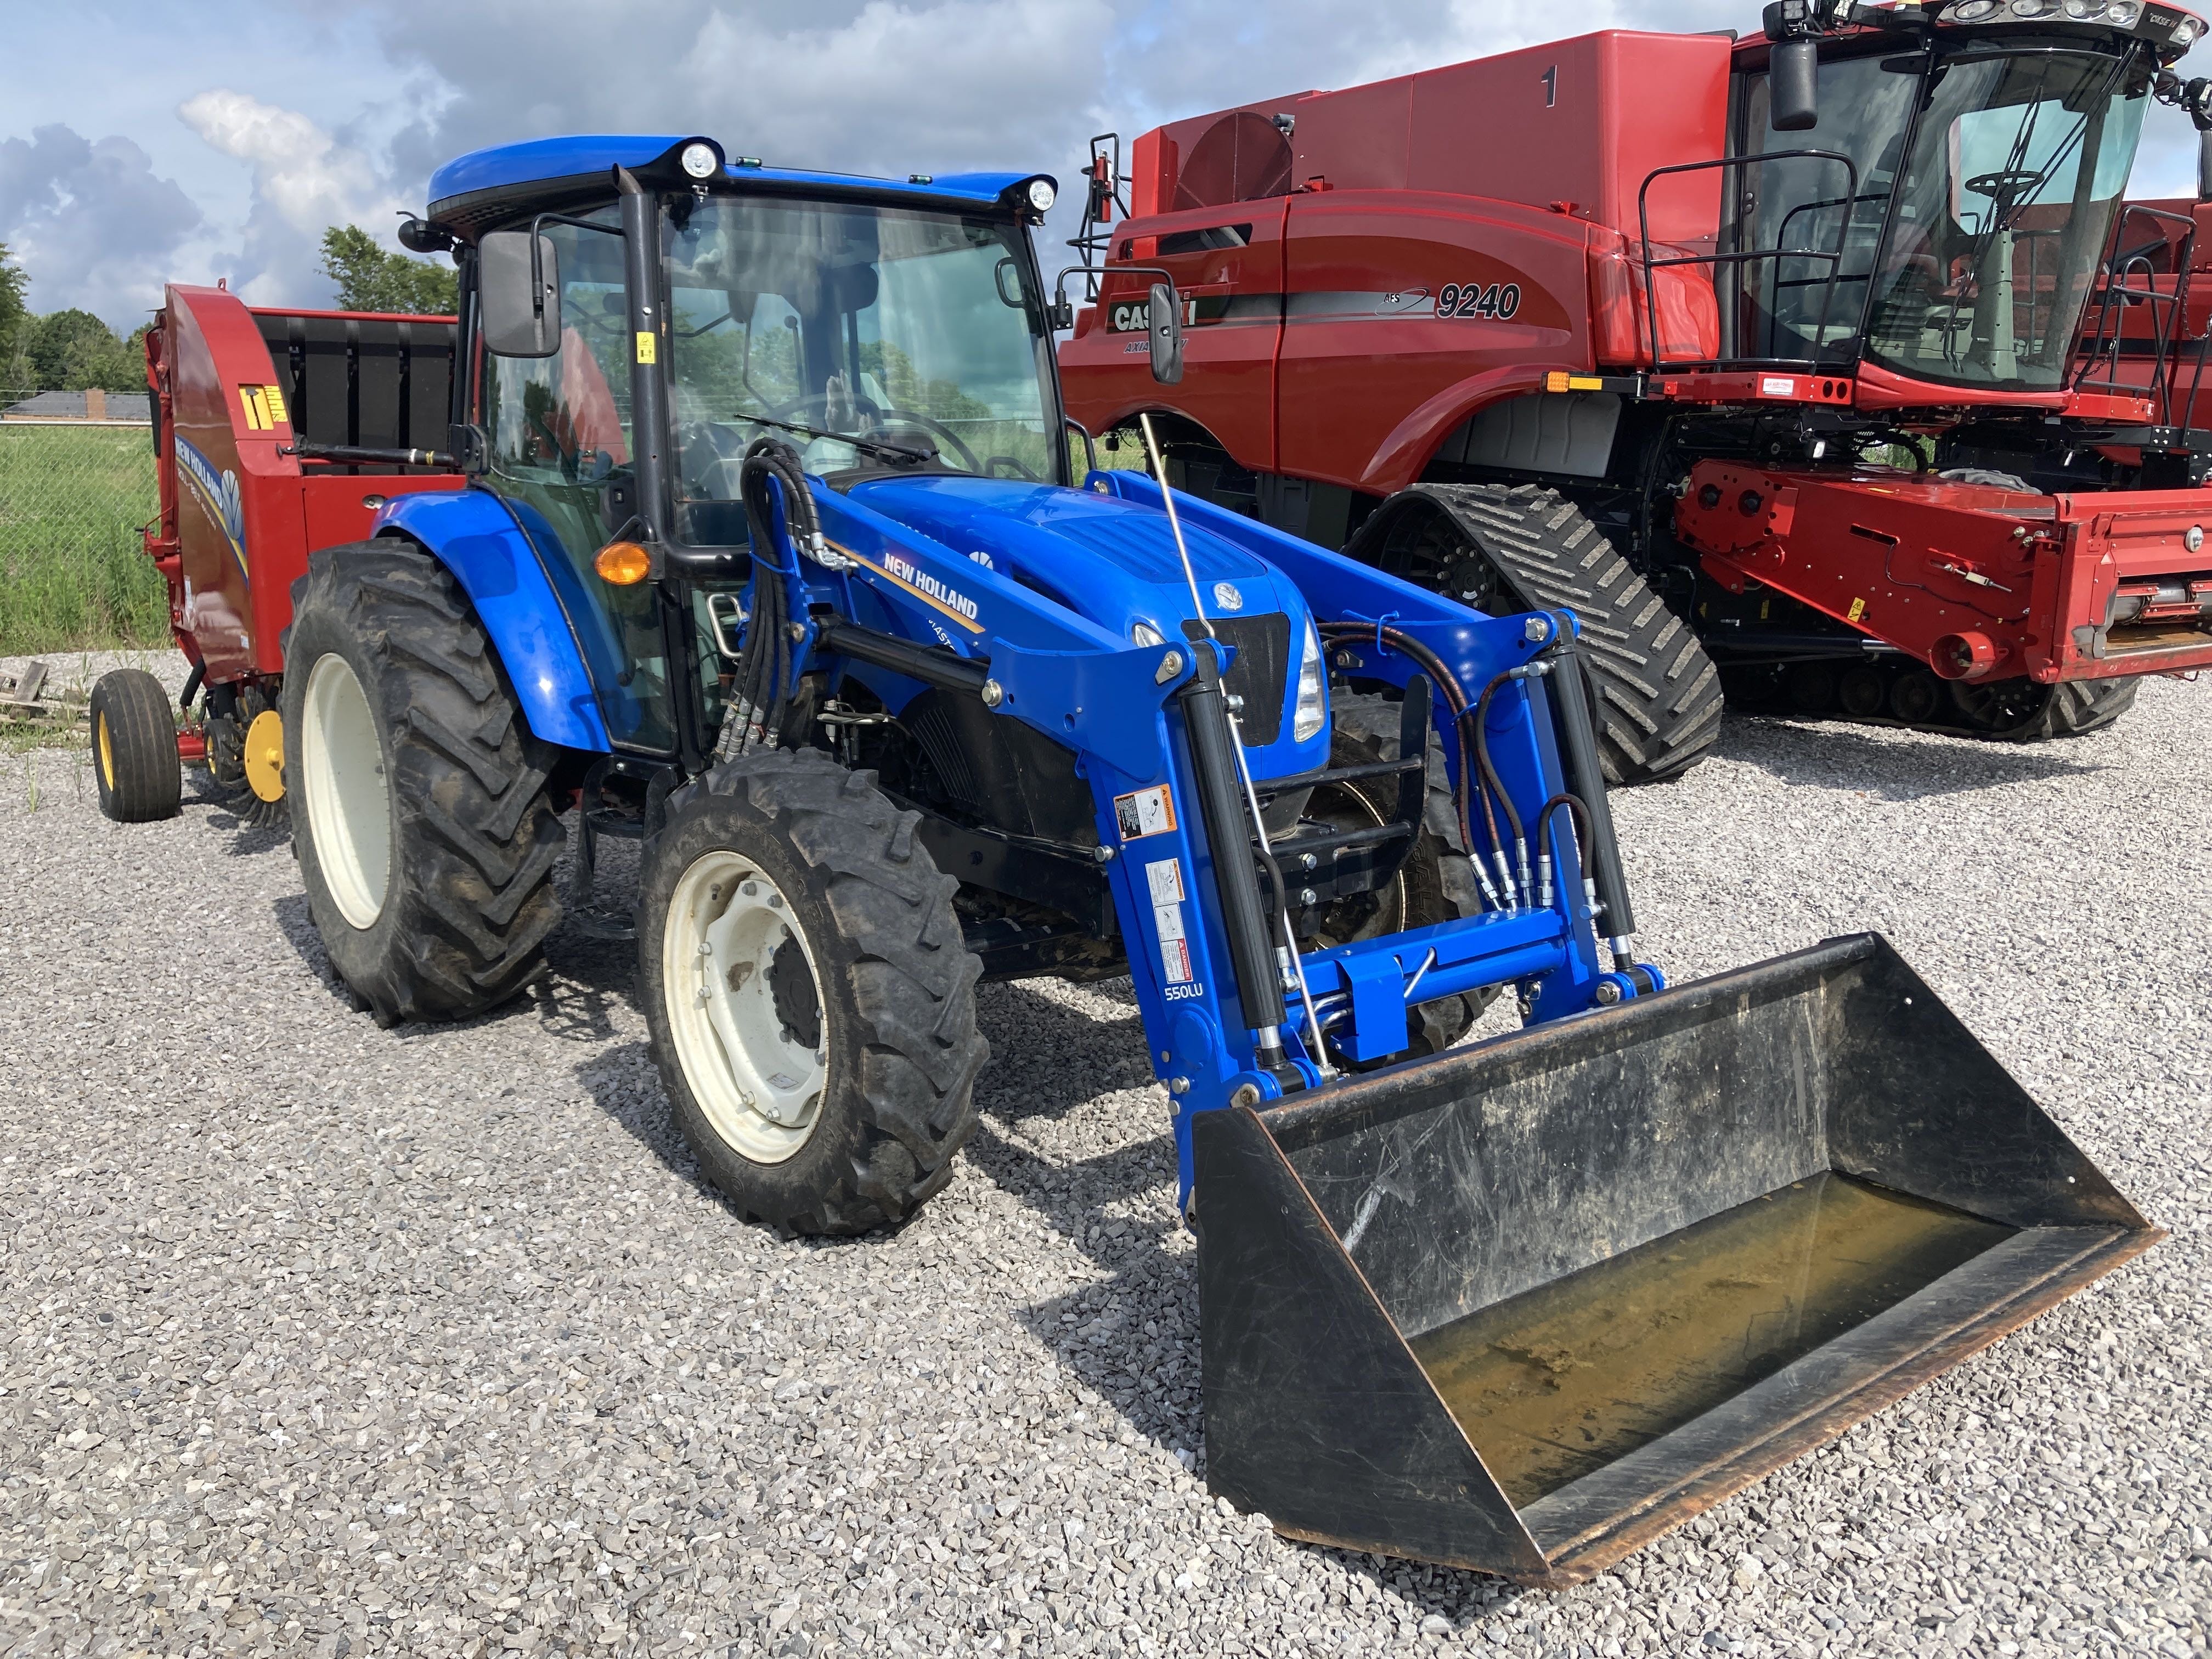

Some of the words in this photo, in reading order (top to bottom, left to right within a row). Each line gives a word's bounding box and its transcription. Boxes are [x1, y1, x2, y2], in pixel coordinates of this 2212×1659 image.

[1541, 64, 1558, 108] 1
[1436, 283, 1521, 320] 9240
[175, 436, 190, 465] NEW
[190, 450, 223, 510] HOLLAND
[884, 552, 915, 583] NEW
[915, 569, 978, 620] HOLLAND
[1163, 797, 1173, 826] WARNING
[1181, 949, 1189, 978] DANGER
[1164, 983, 1204, 1001] 550LU
